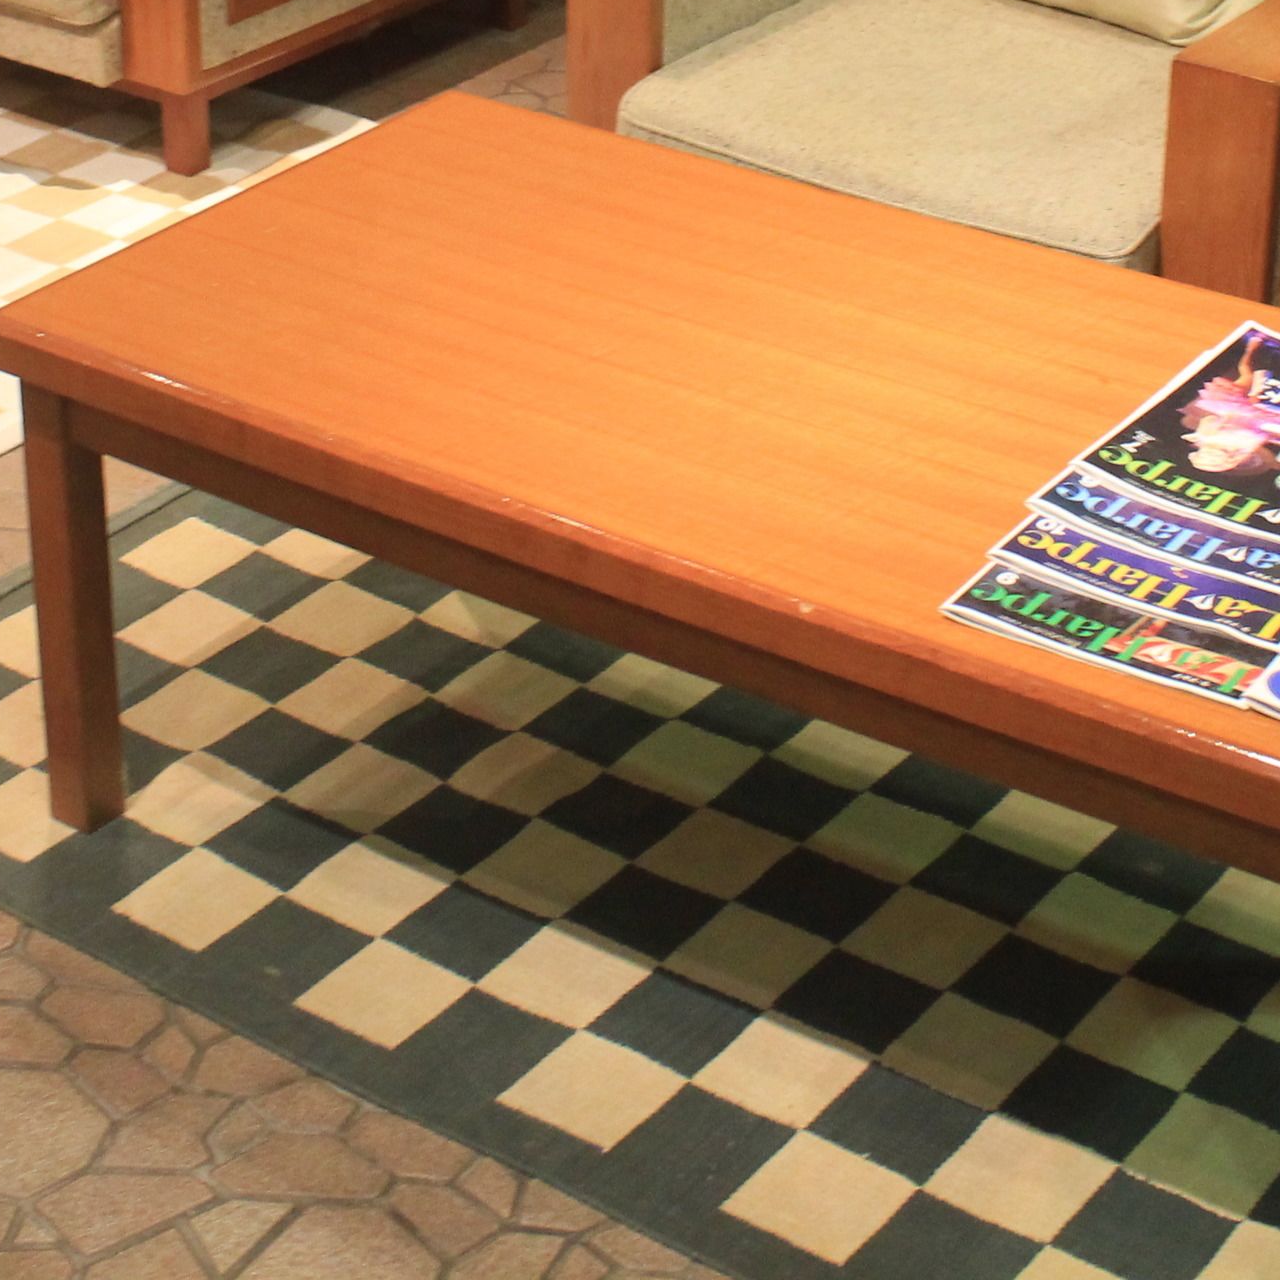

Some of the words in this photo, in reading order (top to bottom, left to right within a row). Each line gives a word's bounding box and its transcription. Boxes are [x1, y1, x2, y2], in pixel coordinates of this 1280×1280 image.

[1051, 480, 1226, 562] Harpe
[1097, 444, 1268, 521] Harpe
[1013, 527, 1196, 610] Harpe
[968, 580, 1148, 661] Harpe
[1174, 650, 1248, 693] La
